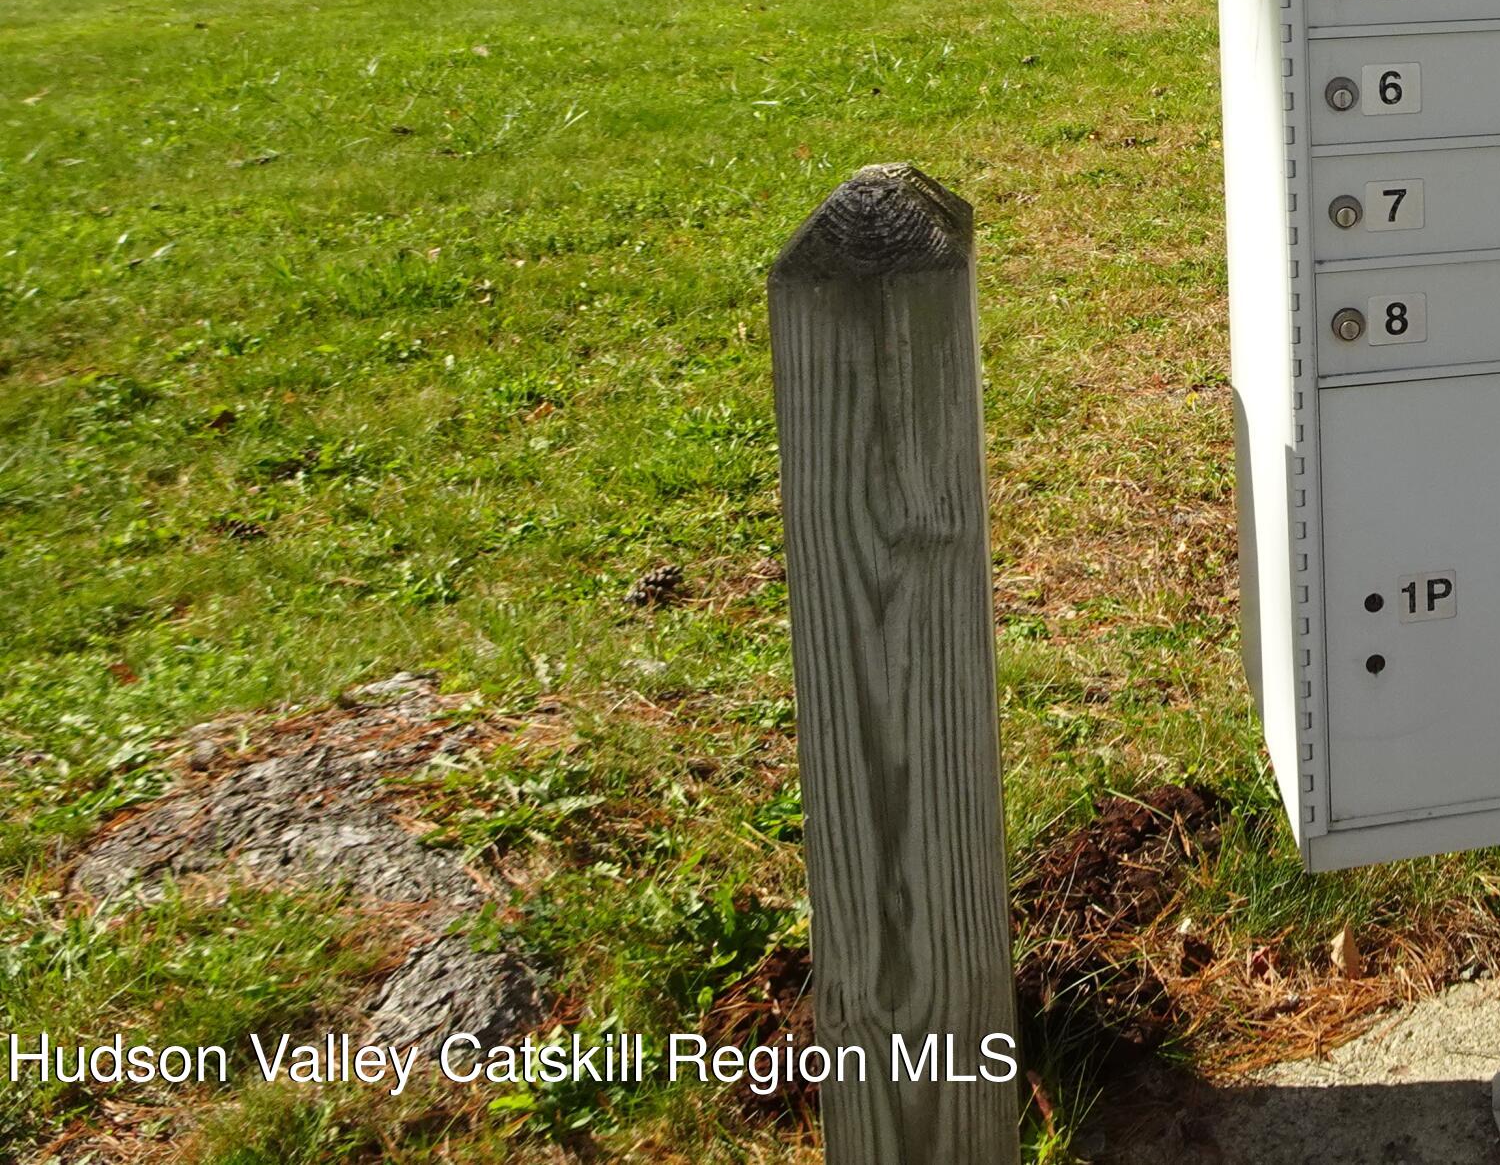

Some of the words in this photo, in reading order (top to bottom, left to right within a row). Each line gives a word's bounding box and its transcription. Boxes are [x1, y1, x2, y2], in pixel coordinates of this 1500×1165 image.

[1379, 70, 1403, 105] 6
[1382, 188, 1407, 222] 7
[1385, 302, 1409, 336] 8
[1401, 578, 1453, 614] 1P
